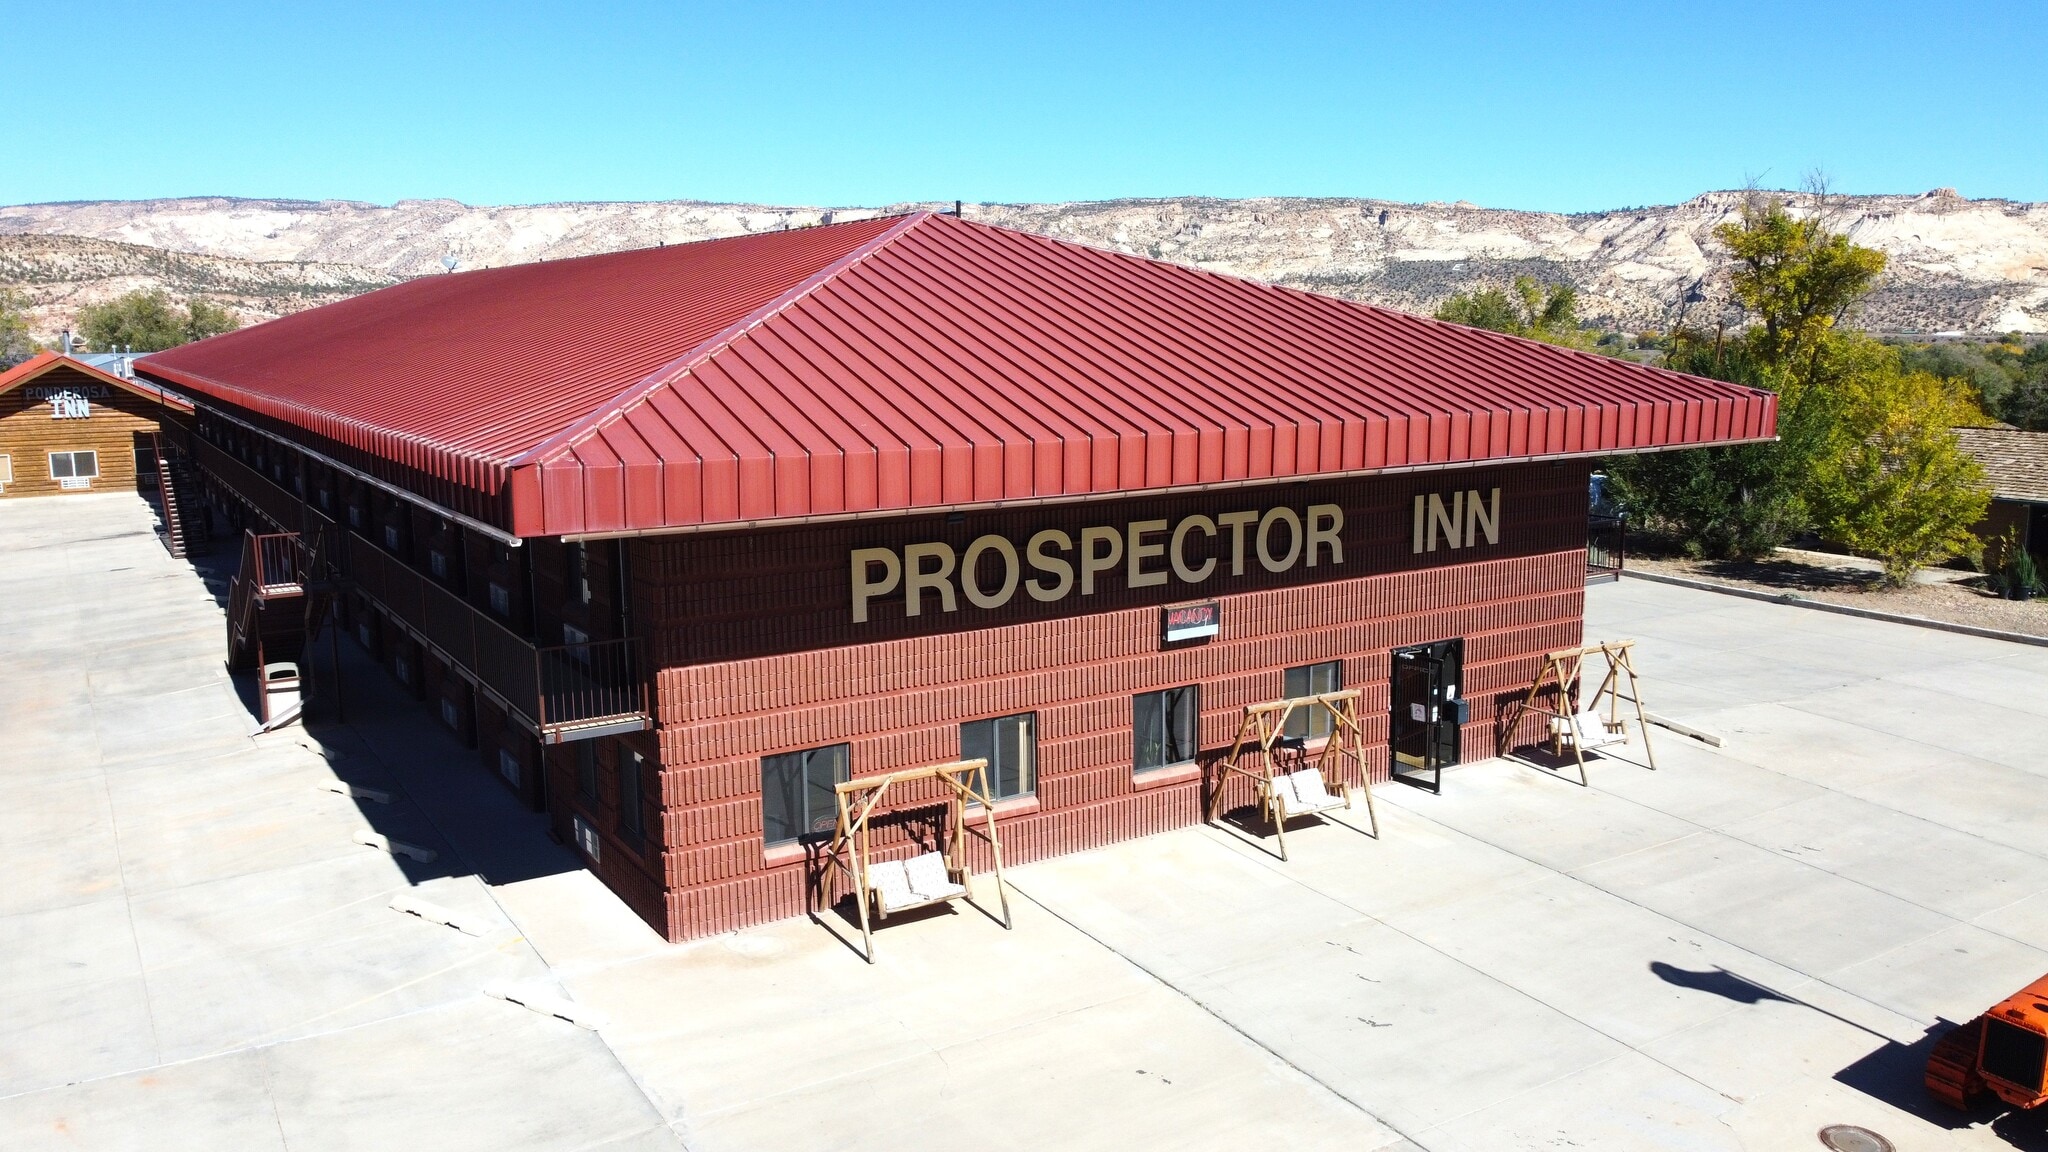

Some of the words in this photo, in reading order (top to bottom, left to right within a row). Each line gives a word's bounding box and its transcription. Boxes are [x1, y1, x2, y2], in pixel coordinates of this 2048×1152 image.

[25, 386, 111, 401] PONDEROSA
[49, 398, 91, 420] INN
[850, 503, 1345, 624] PROSPECTOR
[1412, 487, 1501, 555] INN
